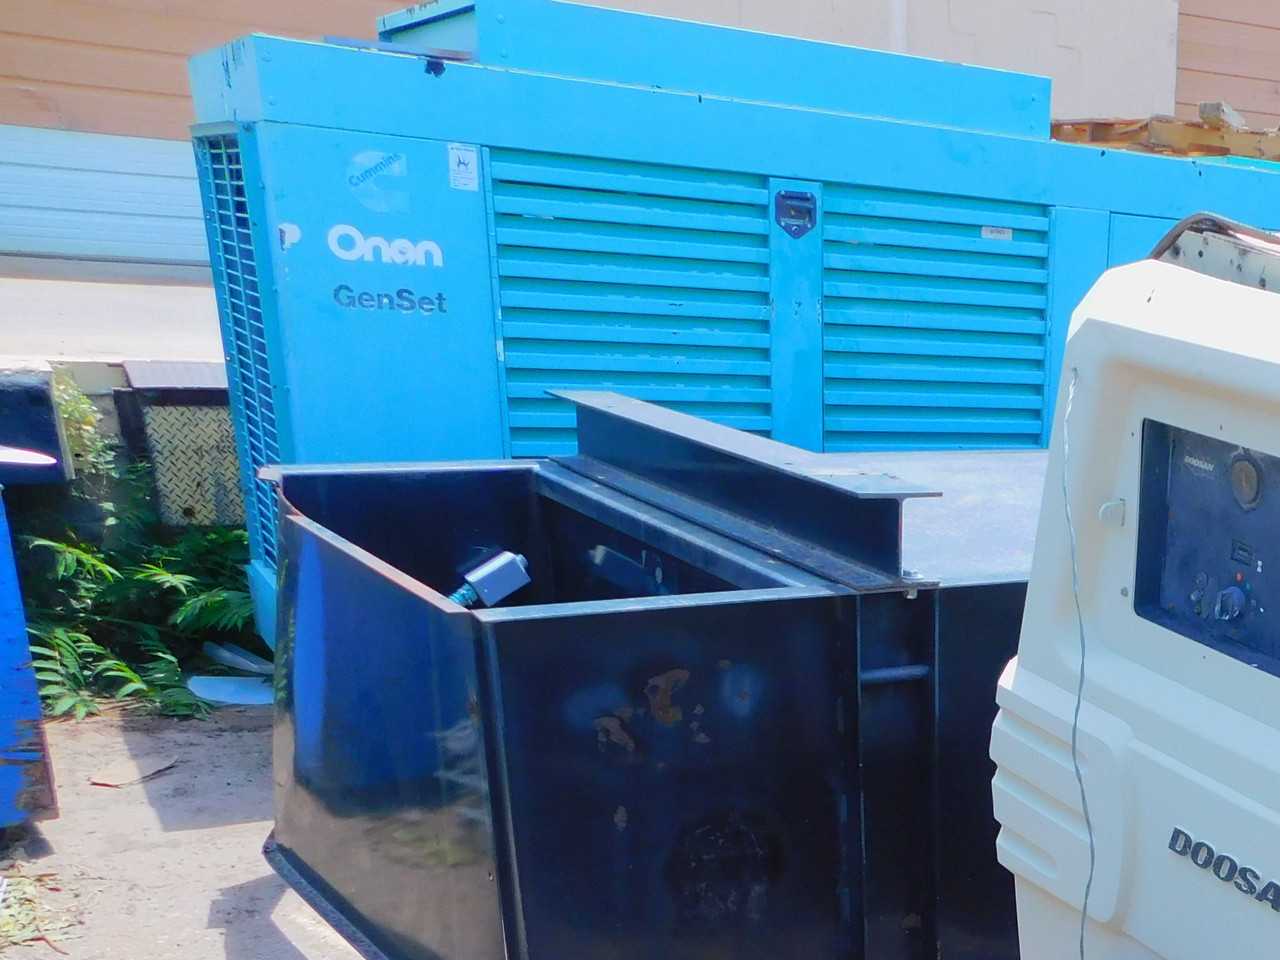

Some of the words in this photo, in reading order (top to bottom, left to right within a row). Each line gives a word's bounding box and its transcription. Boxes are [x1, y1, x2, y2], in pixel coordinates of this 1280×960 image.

[348, 153, 403, 187] Cummins
[328, 223, 444, 267] Onan
[333, 284, 447, 313] GenSet
